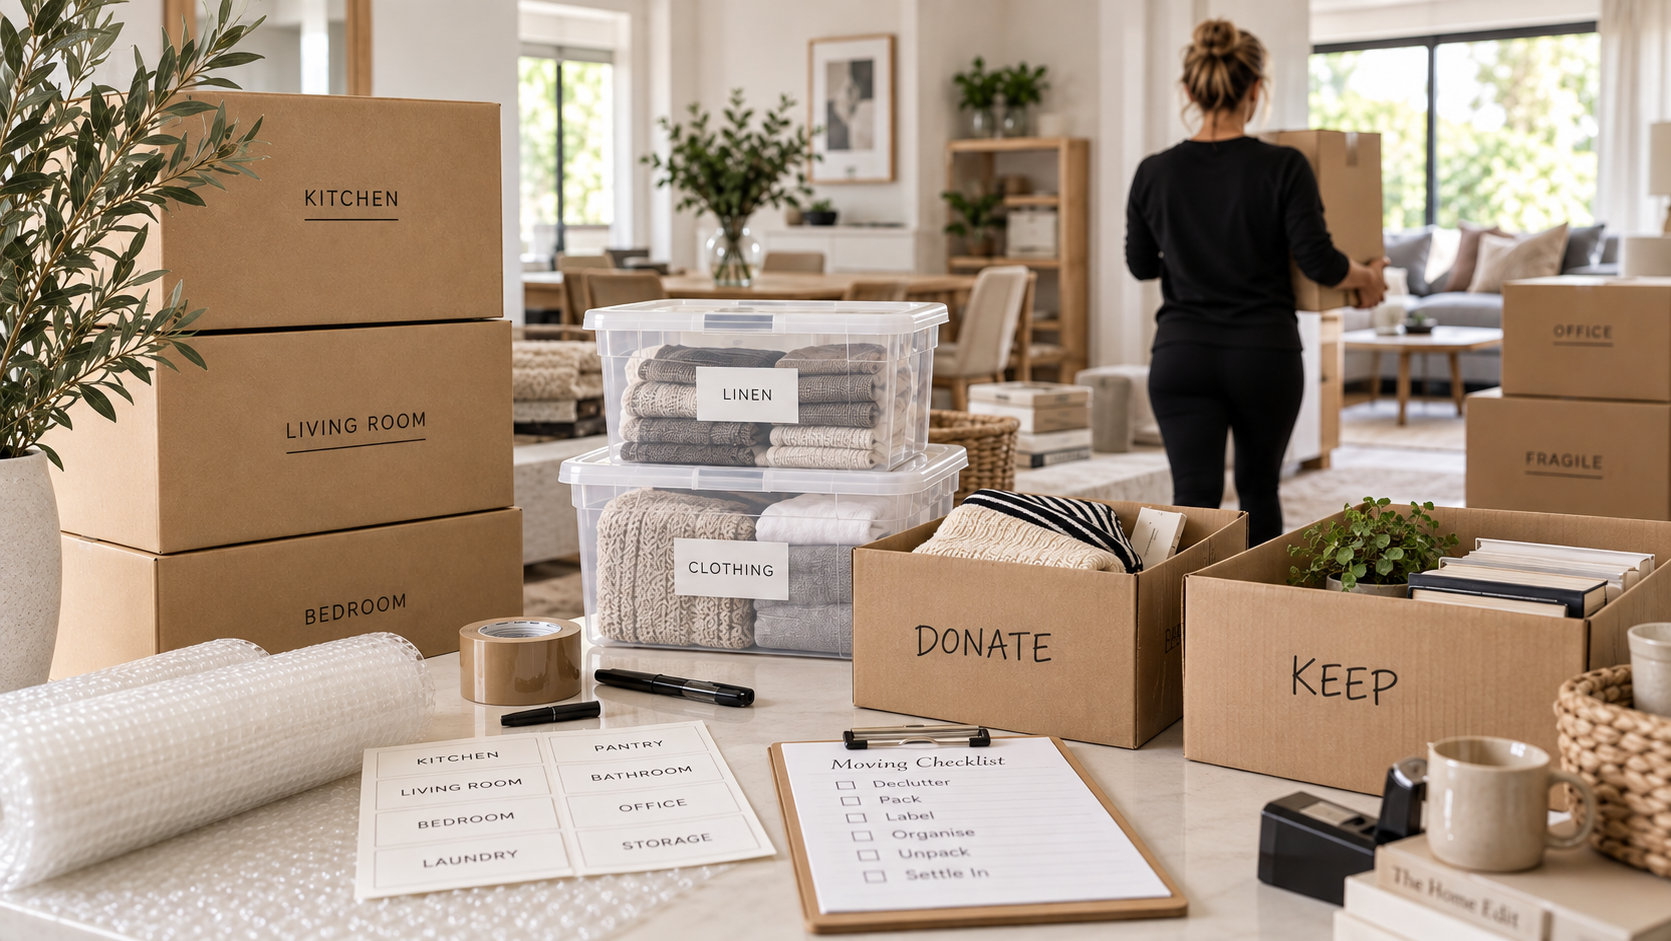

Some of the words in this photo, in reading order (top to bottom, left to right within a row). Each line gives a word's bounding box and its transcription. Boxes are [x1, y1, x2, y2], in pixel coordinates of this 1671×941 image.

[305, 189, 398, 207] KITCHEN
[1553, 324, 1613, 340] OFFICE
[723, 388, 772, 402] LINEN
[286, 417, 358, 439] LIVING
[368, 411, 426, 432] ROOM
[1525, 451, 1603, 470] FRAGILE
[688, 561, 774, 577] CLOTHING
[305, 593, 406, 626] BEDROOM
[914, 624, 1052, 663] DONATE
[1291, 654, 1399, 706] KEEP
[594, 739, 663, 752] PANTRY
[417, 751, 499, 765] KITCHEN
[831, 758, 908, 772] Moving
[916, 755, 1006, 769] Checklist
[590, 765, 693, 782] BATHROOM
[401, 784, 461, 797] LIVING
[467, 778, 522, 790] ROOM
[872, 778, 950, 788] Declutter
[618, 798, 688, 812] OFFICE
[879, 794, 922, 804] Pack
[417, 811, 515, 829] BEDROOM
[885, 810, 935, 822] Label
[622, 833, 713, 850] STORAGE
[891, 828, 976, 841] Organise
[423, 849, 518, 868] LAUNDRY
[898, 846, 971, 861] Unpack
[905, 868, 964, 880] Settle
[970, 867, 990, 878] In
[1392, 866, 1423, 893] The
[1427, 878, 1477, 911] Home
[1481, 898, 1519, 929] Edit
